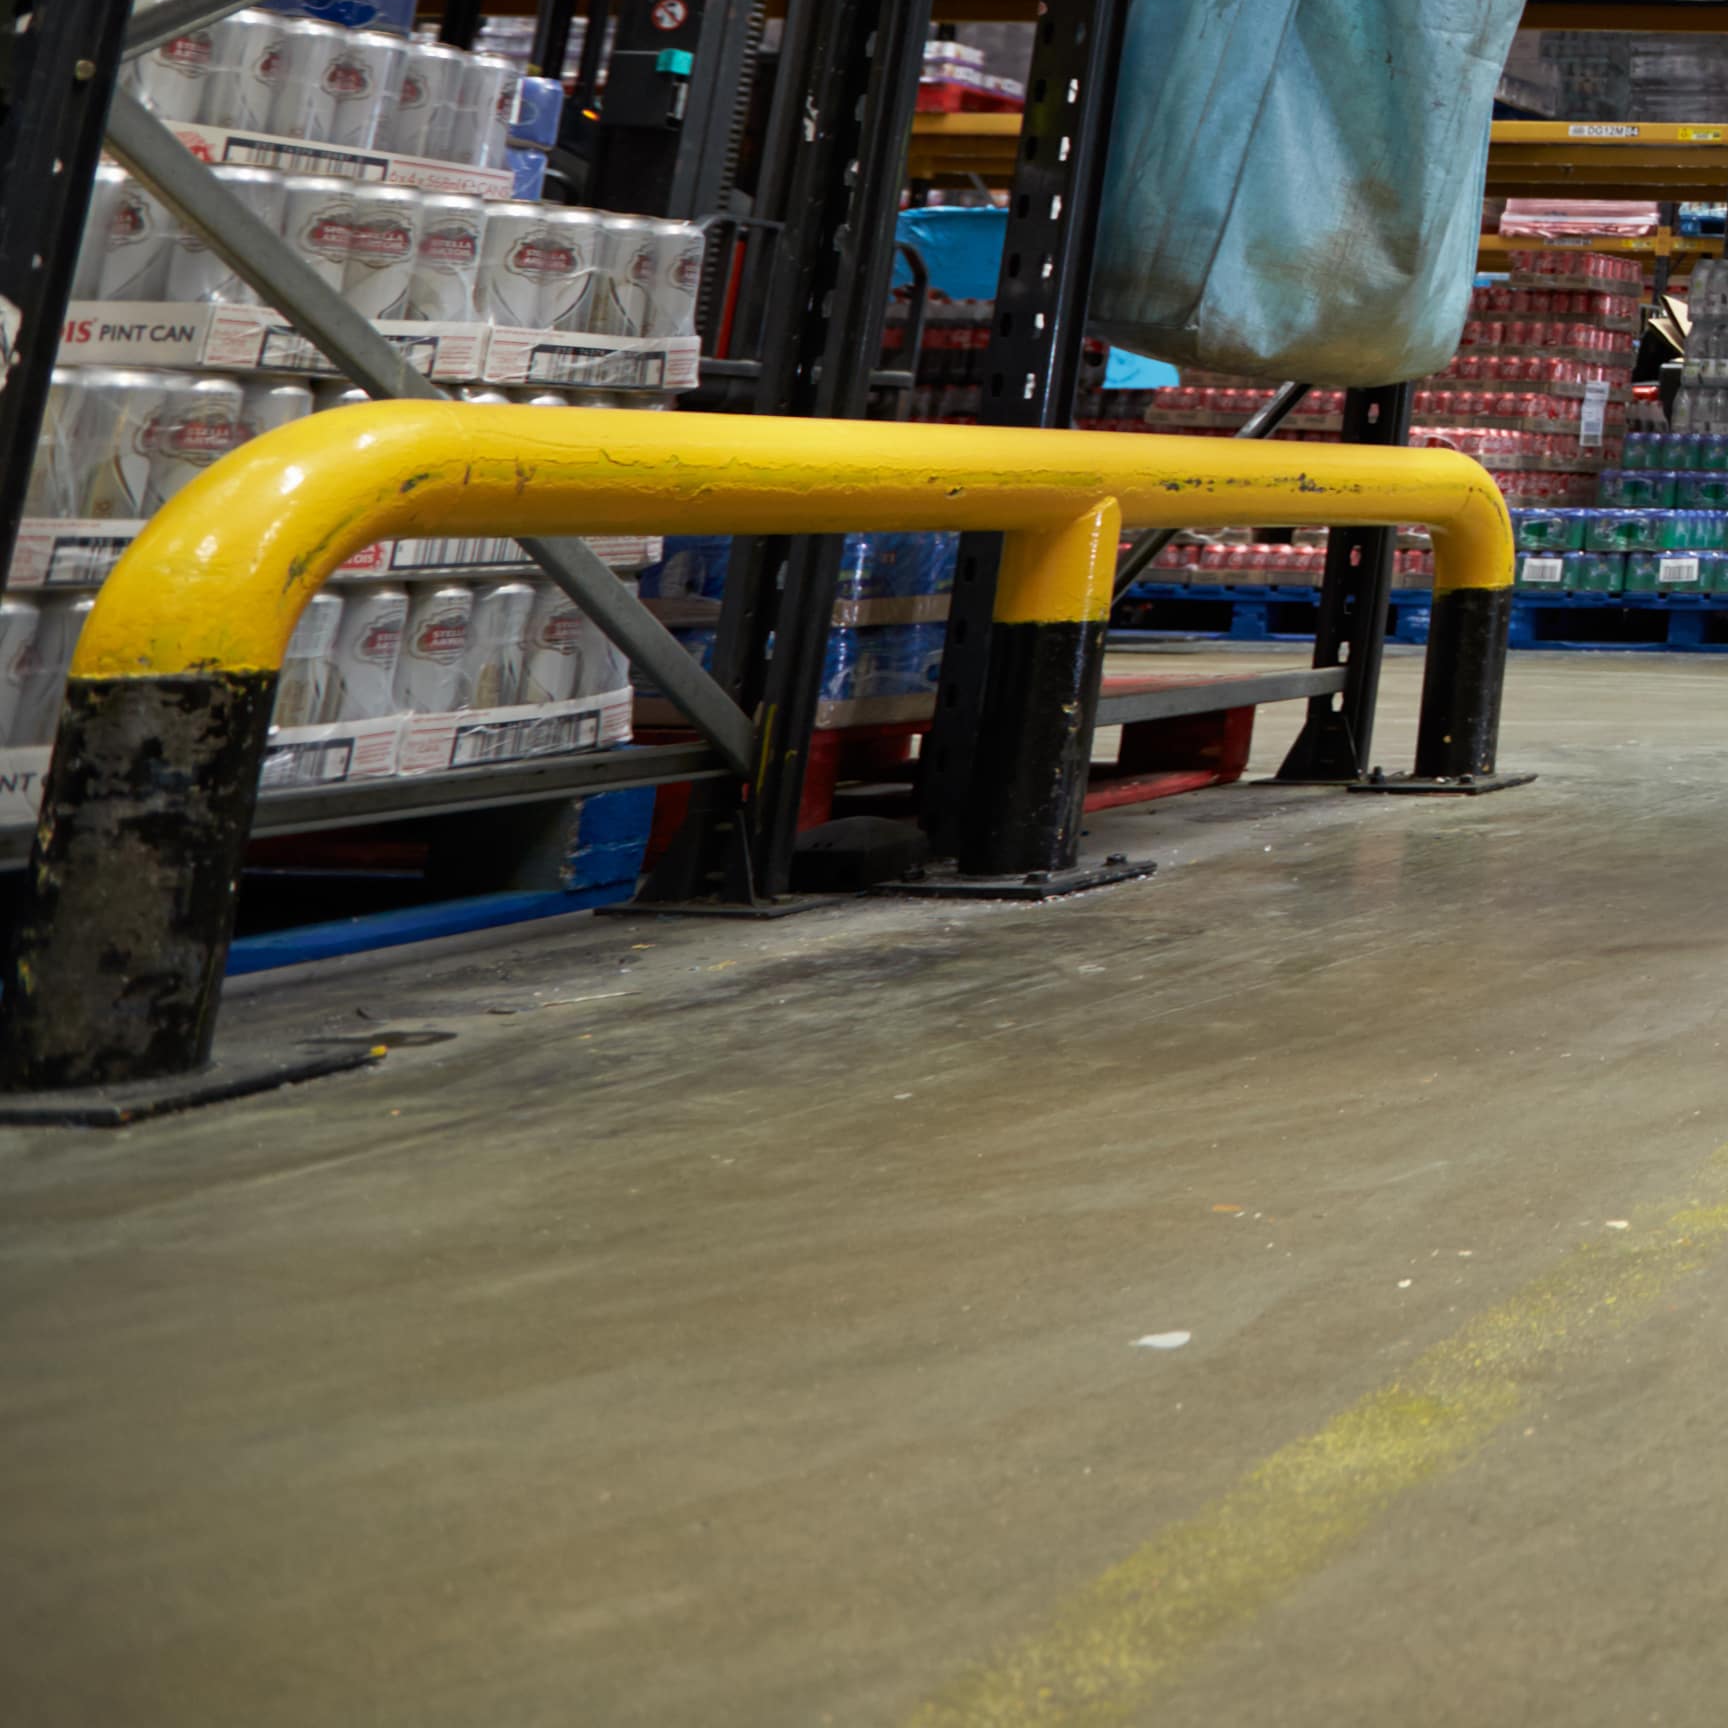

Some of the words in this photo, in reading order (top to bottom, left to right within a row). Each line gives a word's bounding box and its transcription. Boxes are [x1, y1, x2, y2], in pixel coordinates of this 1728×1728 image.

[99, 324, 145, 342] PINT
[151, 325, 195, 343] CAN
[0, 773, 37, 791] NT
